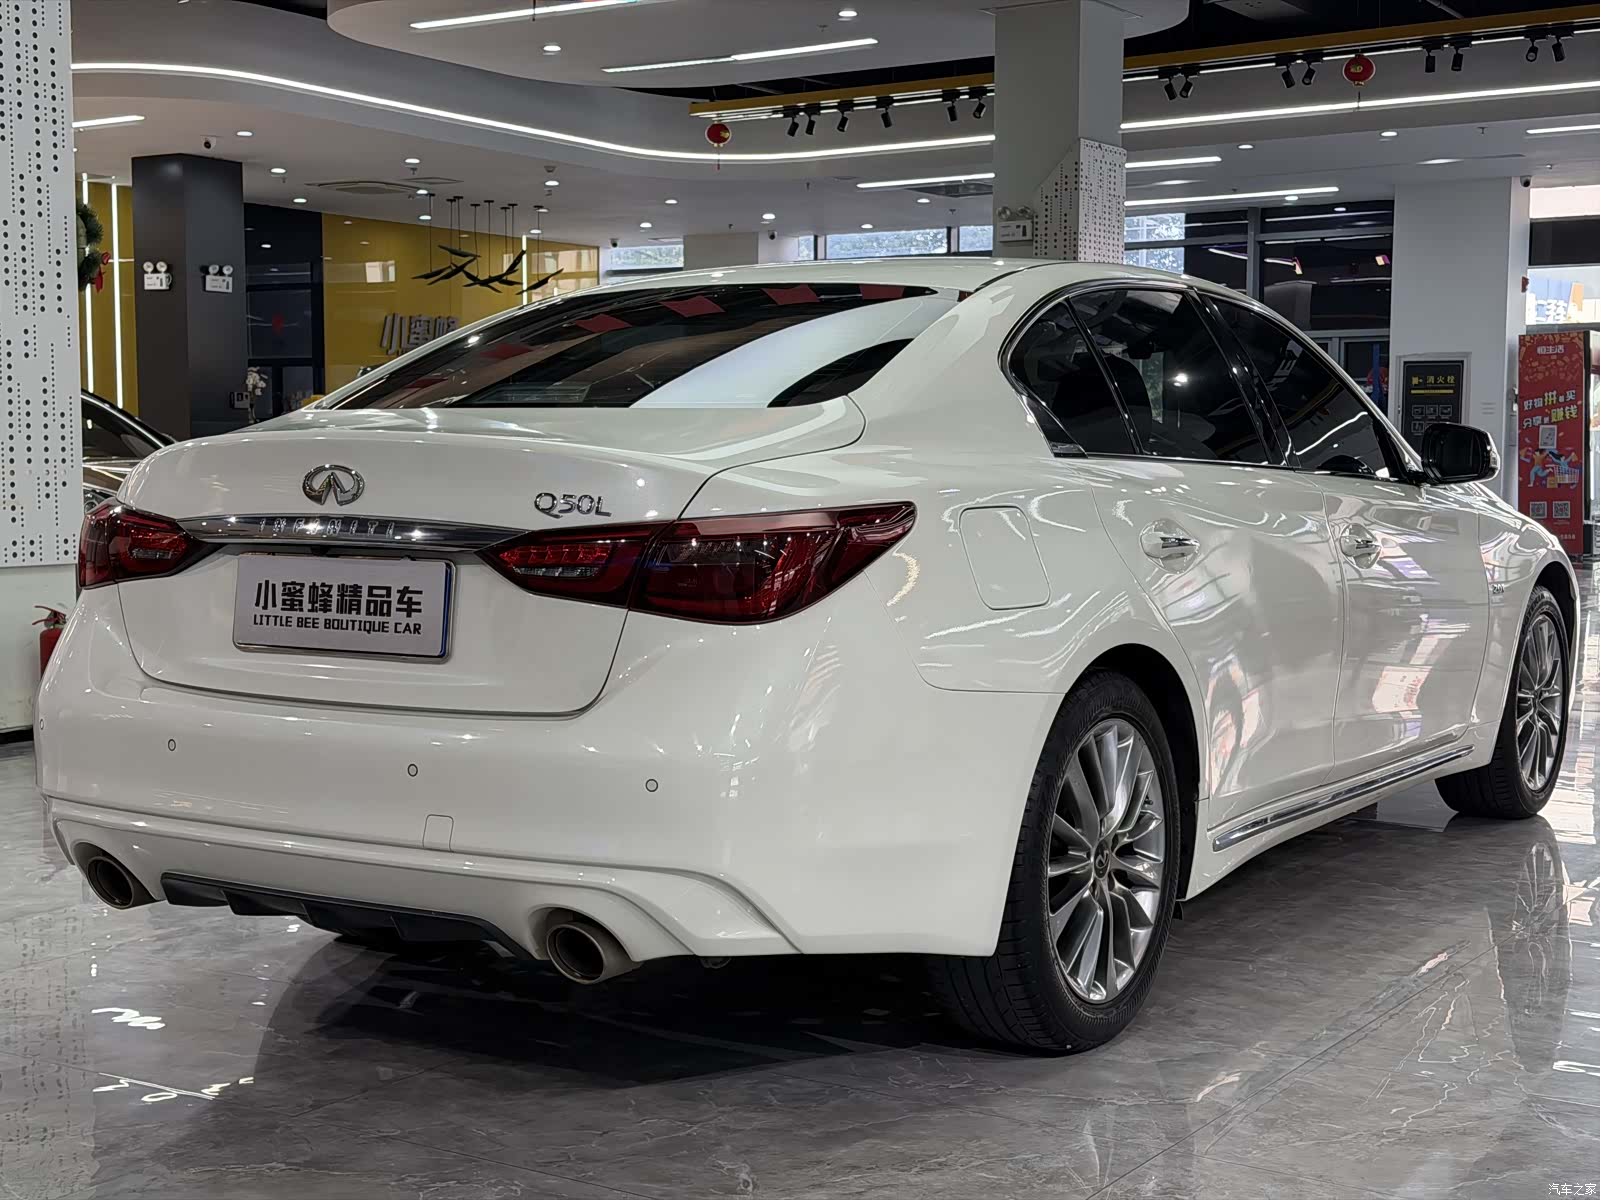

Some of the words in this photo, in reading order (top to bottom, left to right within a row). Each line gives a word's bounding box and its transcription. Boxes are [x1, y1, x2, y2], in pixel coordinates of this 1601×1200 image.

[1426, 375, 1456, 384] 消火栓
[533, 492, 613, 519] Q50L
[257, 517, 396, 538] INFINITI
[254, 579, 424, 618] 小蜜蜂精品车
[253, 613, 293, 627] LITTLE
[296, 616, 320, 629] BEE
[323, 618, 390, 635] BOUTIQUE
[394, 621, 422, 636] CAR
